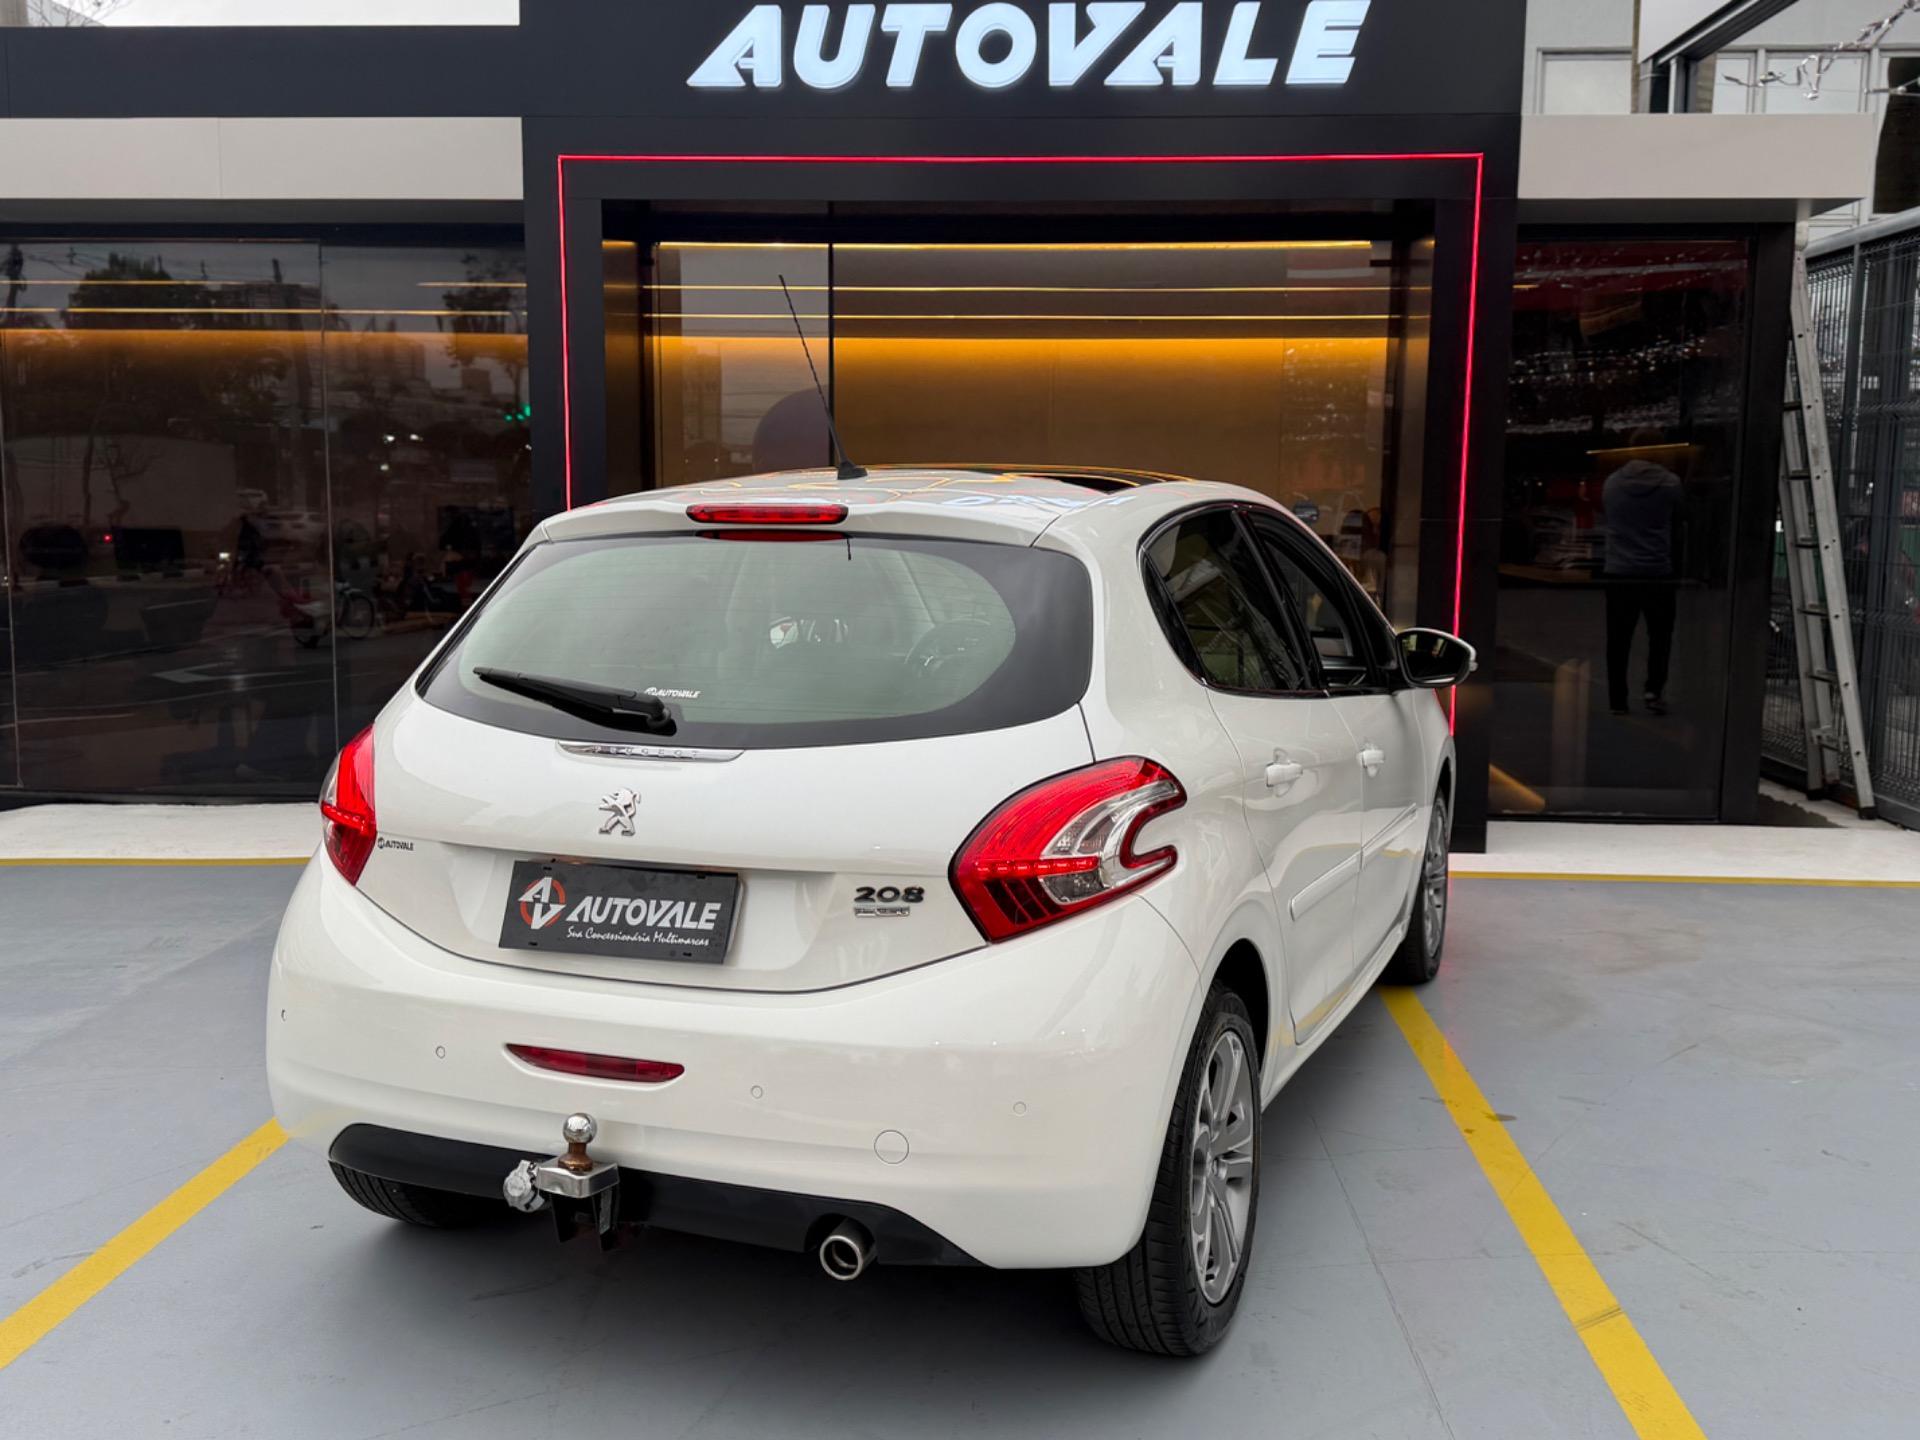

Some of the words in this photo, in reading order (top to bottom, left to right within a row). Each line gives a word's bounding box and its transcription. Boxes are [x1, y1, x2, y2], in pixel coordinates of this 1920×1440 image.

[686, 0, 1371, 90] AUTOVALE
[854, 886, 925, 904] 208
[565, 895, 722, 931] AUTOVALE
[566, 926, 583, 938] Sua
[652, 931, 709, 946] Multimarcas
